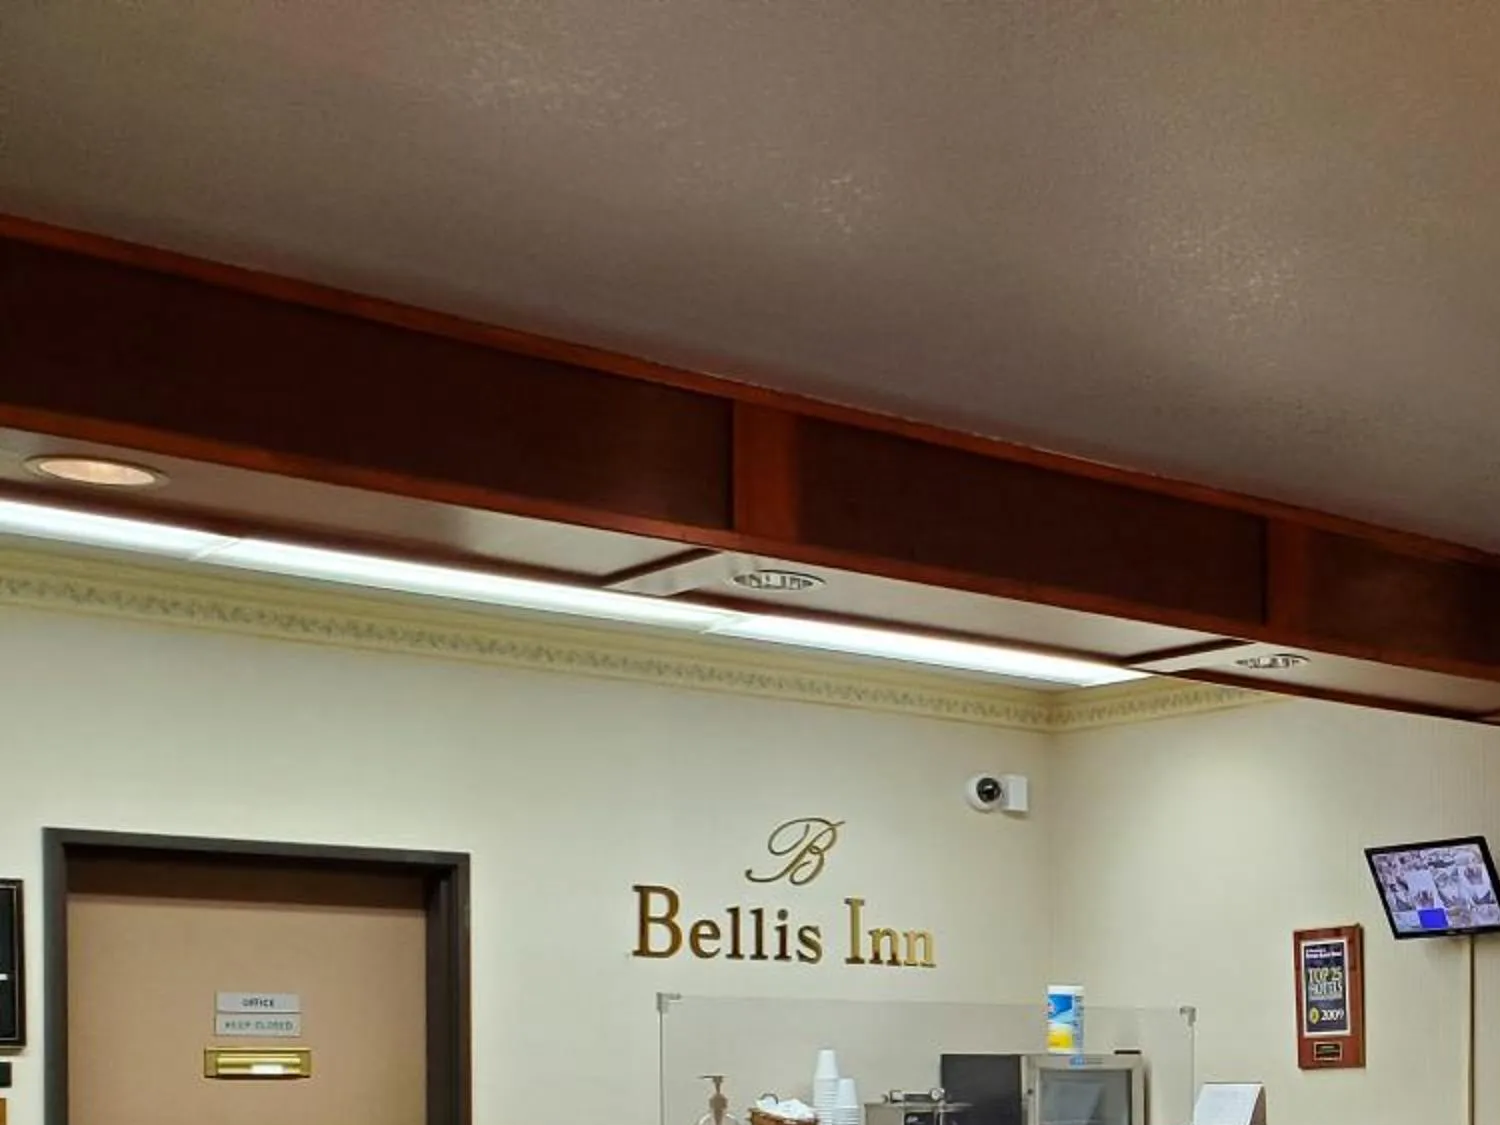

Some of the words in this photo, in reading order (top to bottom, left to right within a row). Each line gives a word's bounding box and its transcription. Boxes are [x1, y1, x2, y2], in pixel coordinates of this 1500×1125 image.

[745, 817, 846, 886] B
[632, 884, 823, 964] Bellis
[844, 897, 936, 968] Inn
[241, 998, 275, 1008] OFFICE
